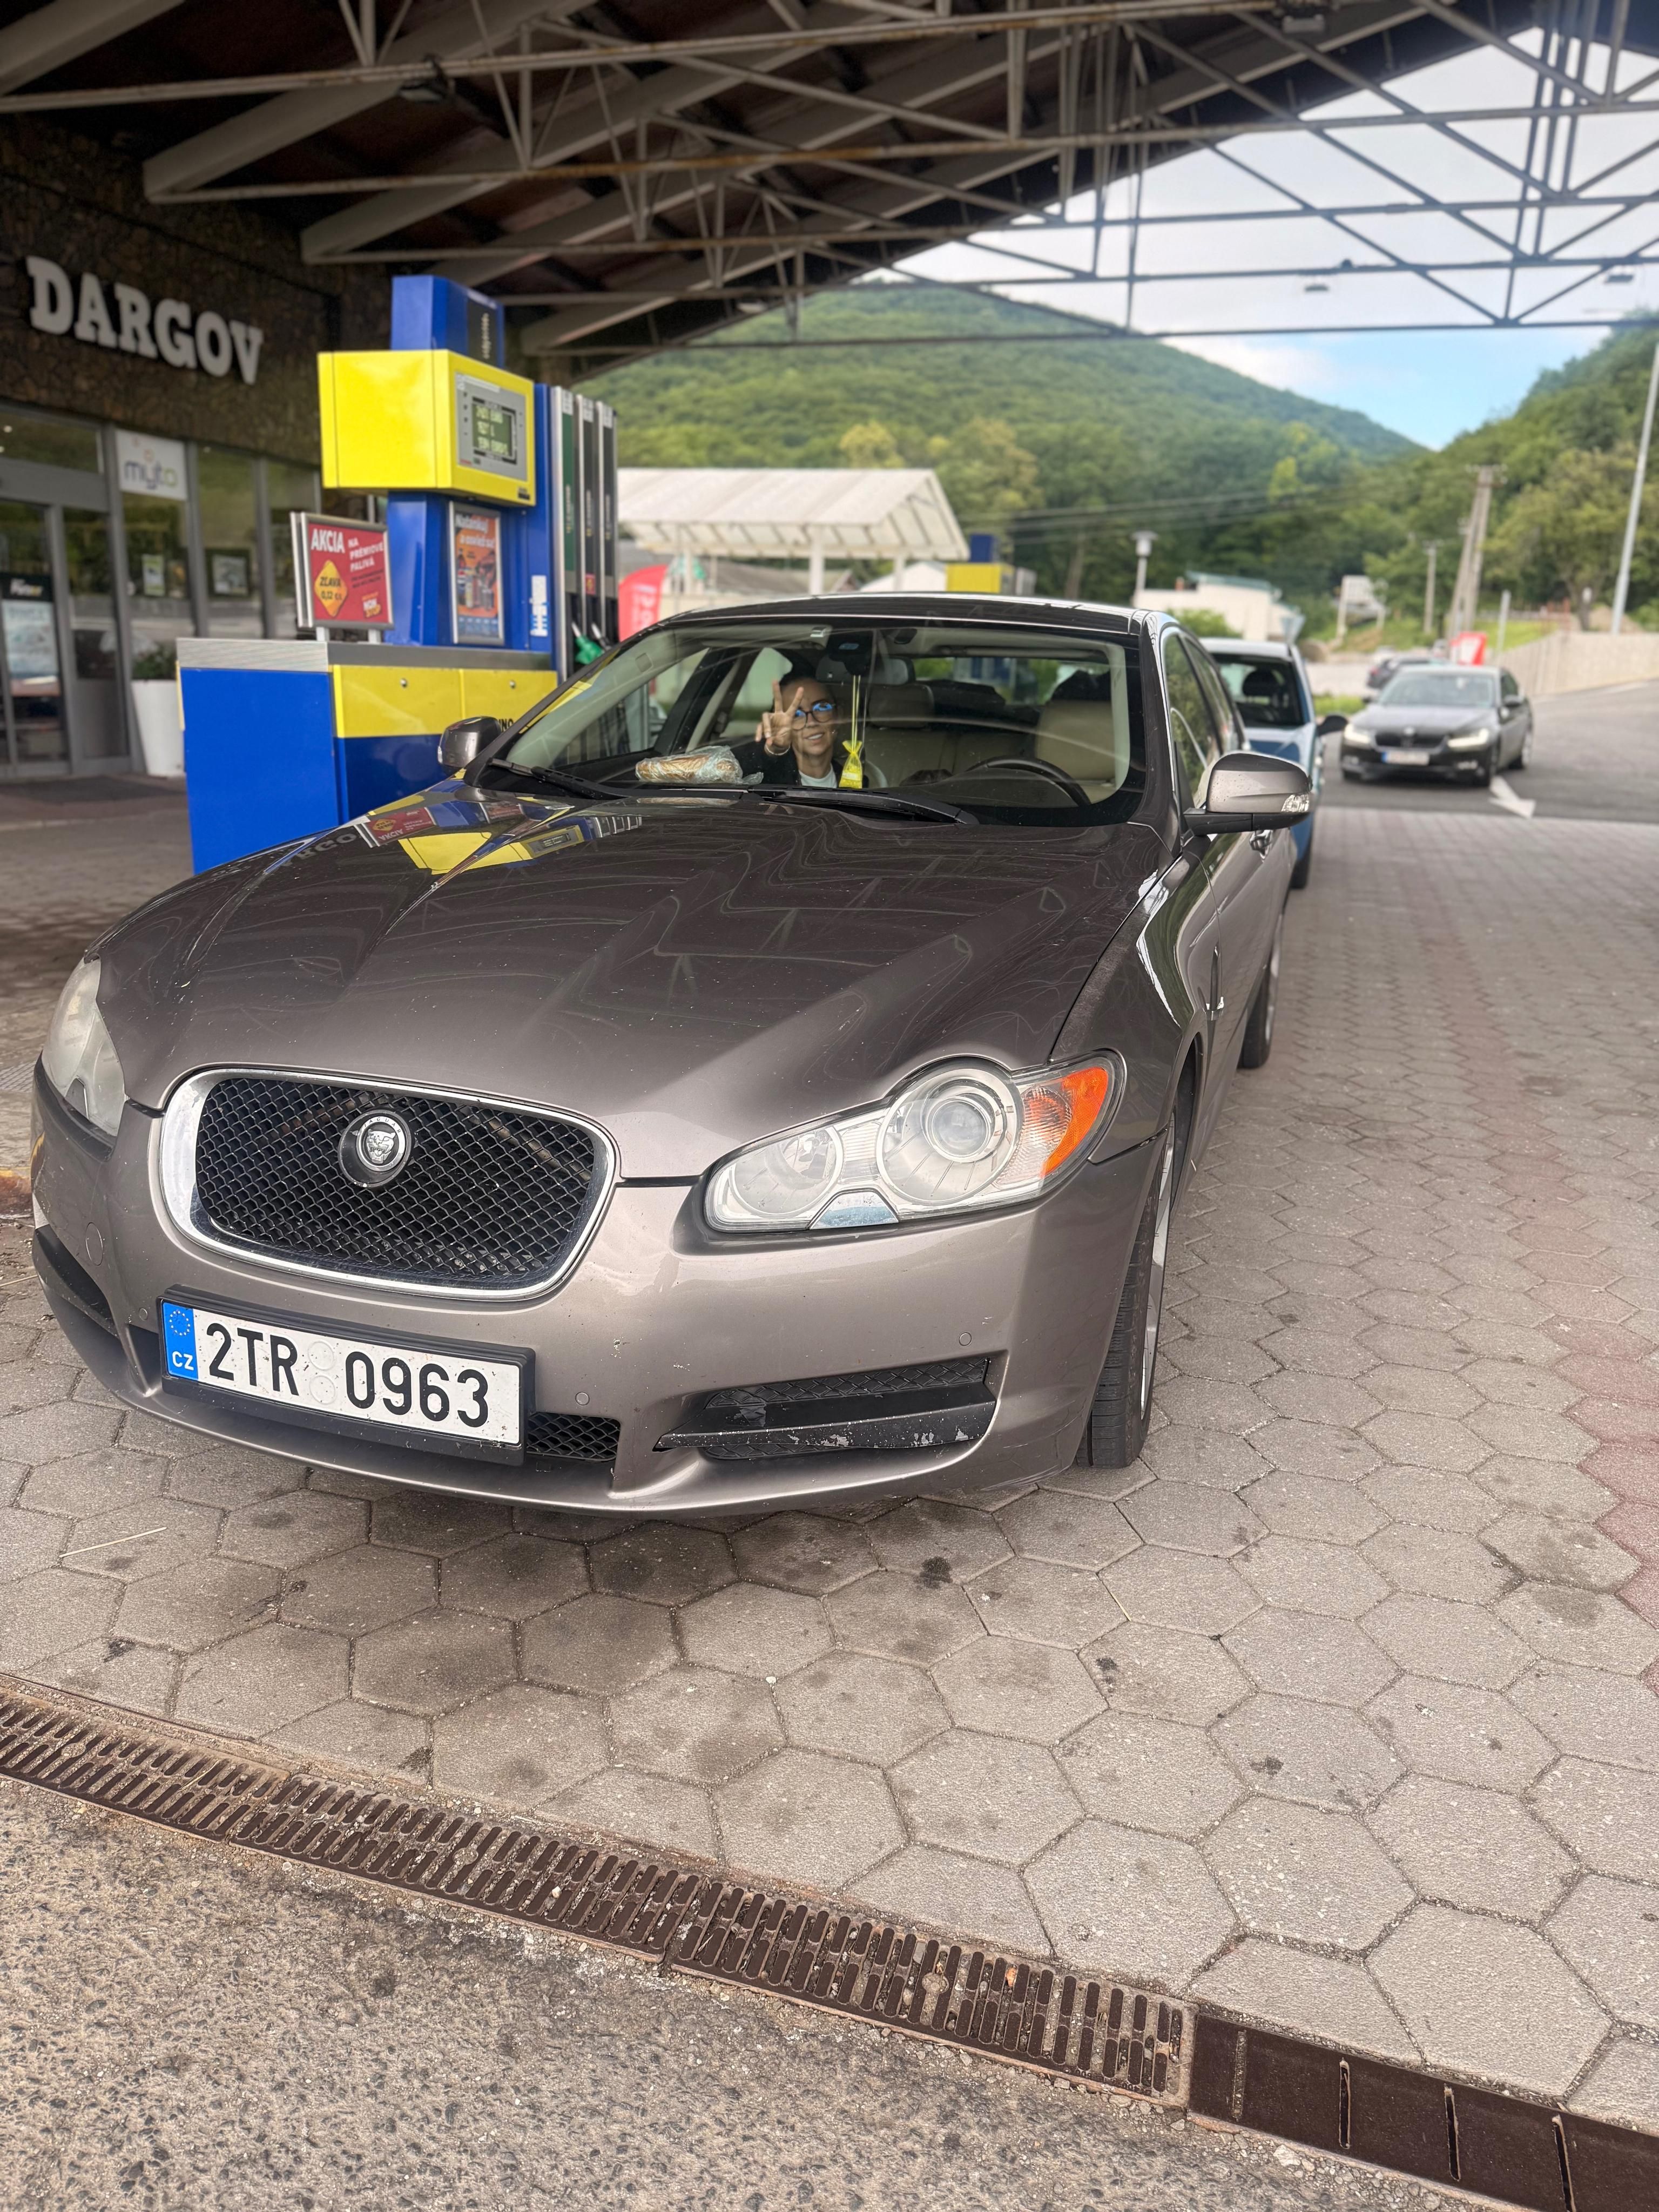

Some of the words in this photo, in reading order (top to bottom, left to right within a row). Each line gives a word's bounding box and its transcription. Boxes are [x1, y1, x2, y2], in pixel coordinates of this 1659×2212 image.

[26, 255, 264, 385] DARGOV
[311, 528, 345, 554] AKCIA
[364, 1116, 402, 1134] JAGUAR
[172, 1350, 194, 1372] CZ
[206, 1323, 300, 1396] 2TR
[346, 1352, 489, 1428] 0963
